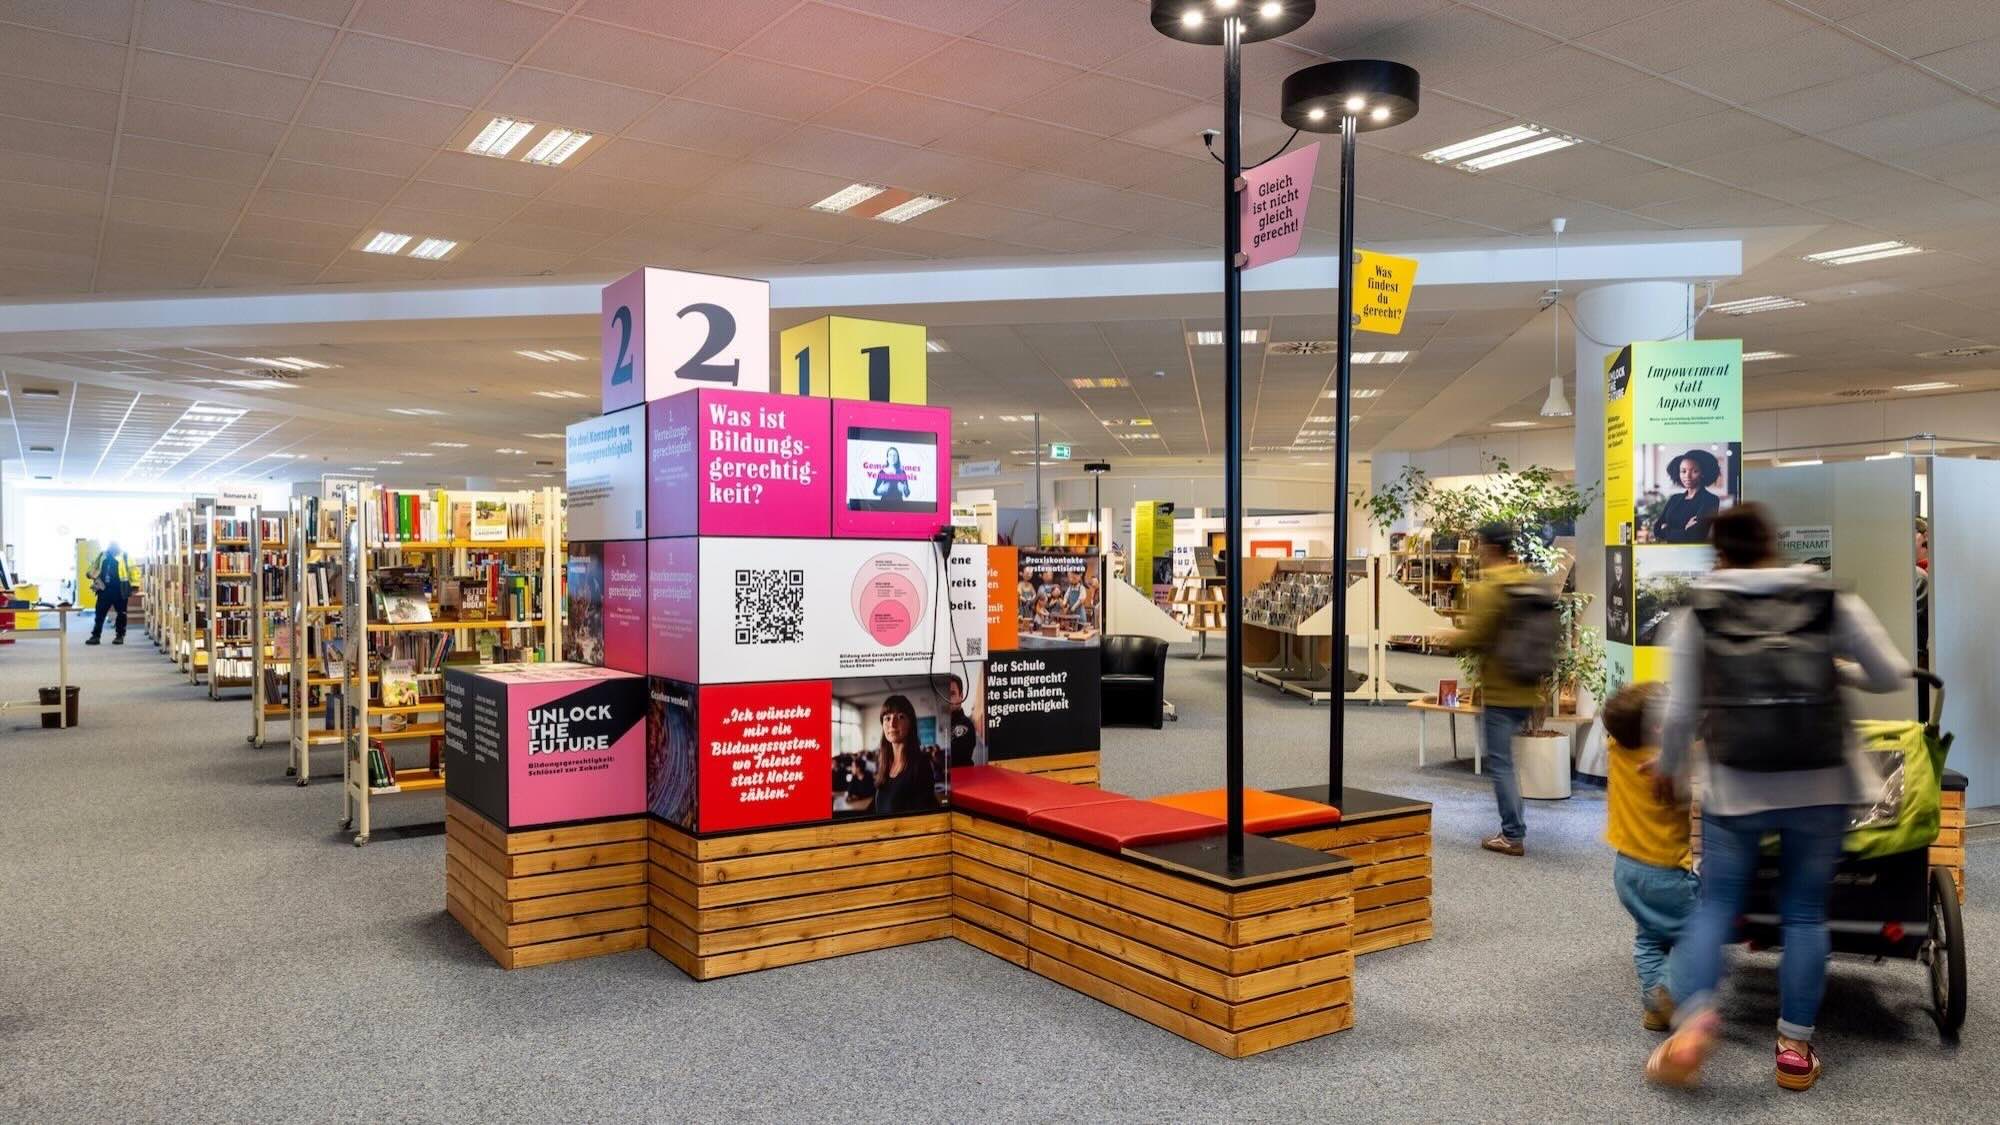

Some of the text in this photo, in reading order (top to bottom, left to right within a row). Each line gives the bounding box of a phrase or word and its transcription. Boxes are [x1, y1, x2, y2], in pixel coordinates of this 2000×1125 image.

[1259, 174, 1293, 197] Gleich
[1253, 188, 1299, 215] ist nicht
[1259, 208, 1293, 231] gleich
[1253, 218, 1299, 247] gerecht!
[1376, 265, 1392, 278] Was
[1368, 278, 1398, 293] findest
[1378, 292, 1388, 304] du
[1364, 304, 1402, 319] gerecht?
[611, 305, 632, 387] 2
[674, 303, 739, 386] 2
[795, 346, 810, 397] 1
[861, 346, 890, 401] 1
[1648, 364, 1729, 380] Empowerment
[1674, 380, 1703, 392] statt
[1656, 397, 1720, 411] Anpassung
[709, 403, 786, 429] Was ist
[709, 430, 811, 458] Bildungs-
[709, 456, 817, 485] gerechtig-
[709, 482, 763, 505] keit?
[1026, 556, 1084, 564] Praxiskontakte
[1026, 565, 1086, 573] systematisieren
[952, 577, 976, 587] reits
[950, 600, 976, 610] beit.
[990, 660, 1045, 672] der Schule
[988, 672, 1068, 687] Was ungerecht?
[1003, 687, 1024, 699] sich
[1027, 686, 1065, 699] ändern,
[528, 704, 612, 724] UNLOCK
[756, 706, 812, 721] wünsche
[528, 724, 569, 740] THE
[743, 723, 792, 738] mir ein
[528, 735, 609, 755] FUTURE
[711, 738, 820, 757] Bildungssystem,
[528, 756, 614, 769] Bildungsgerechtigkeit:
[528, 767, 562, 776] Schlüssel
[579, 764, 609, 772] Zukunft
[732, 754, 802, 770] wo Talente
[730, 770, 804, 787] statt Noten
